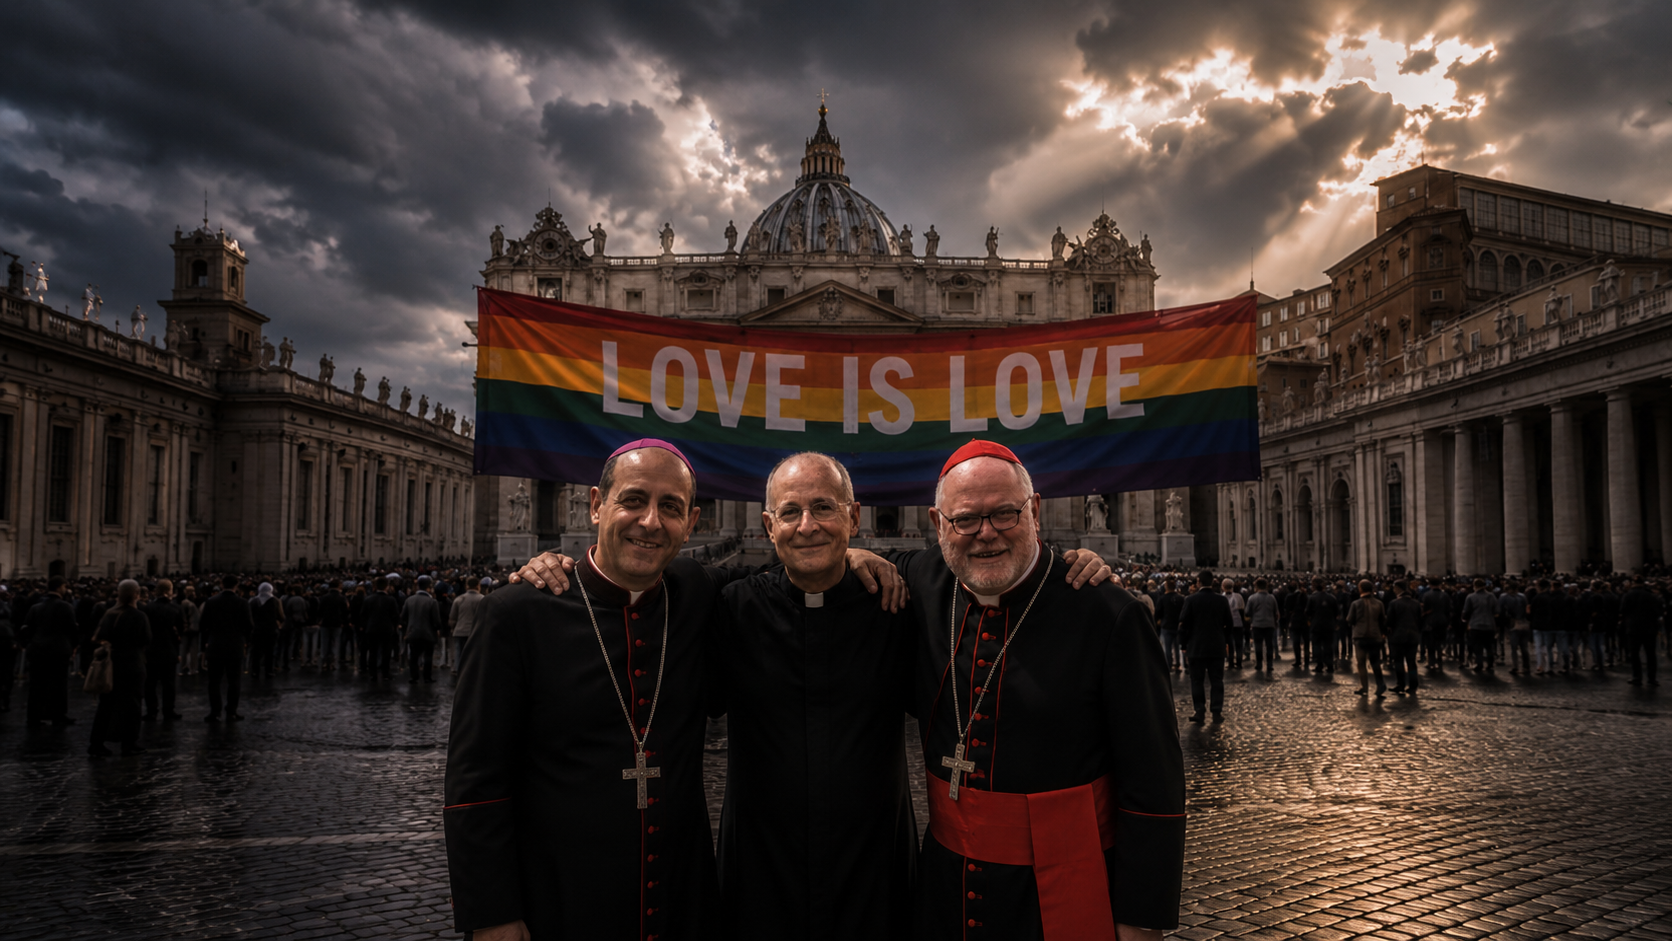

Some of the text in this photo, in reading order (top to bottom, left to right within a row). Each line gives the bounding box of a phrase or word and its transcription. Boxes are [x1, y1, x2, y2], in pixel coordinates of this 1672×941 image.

[602, 340, 1145, 435] LOVE IS LOVE
